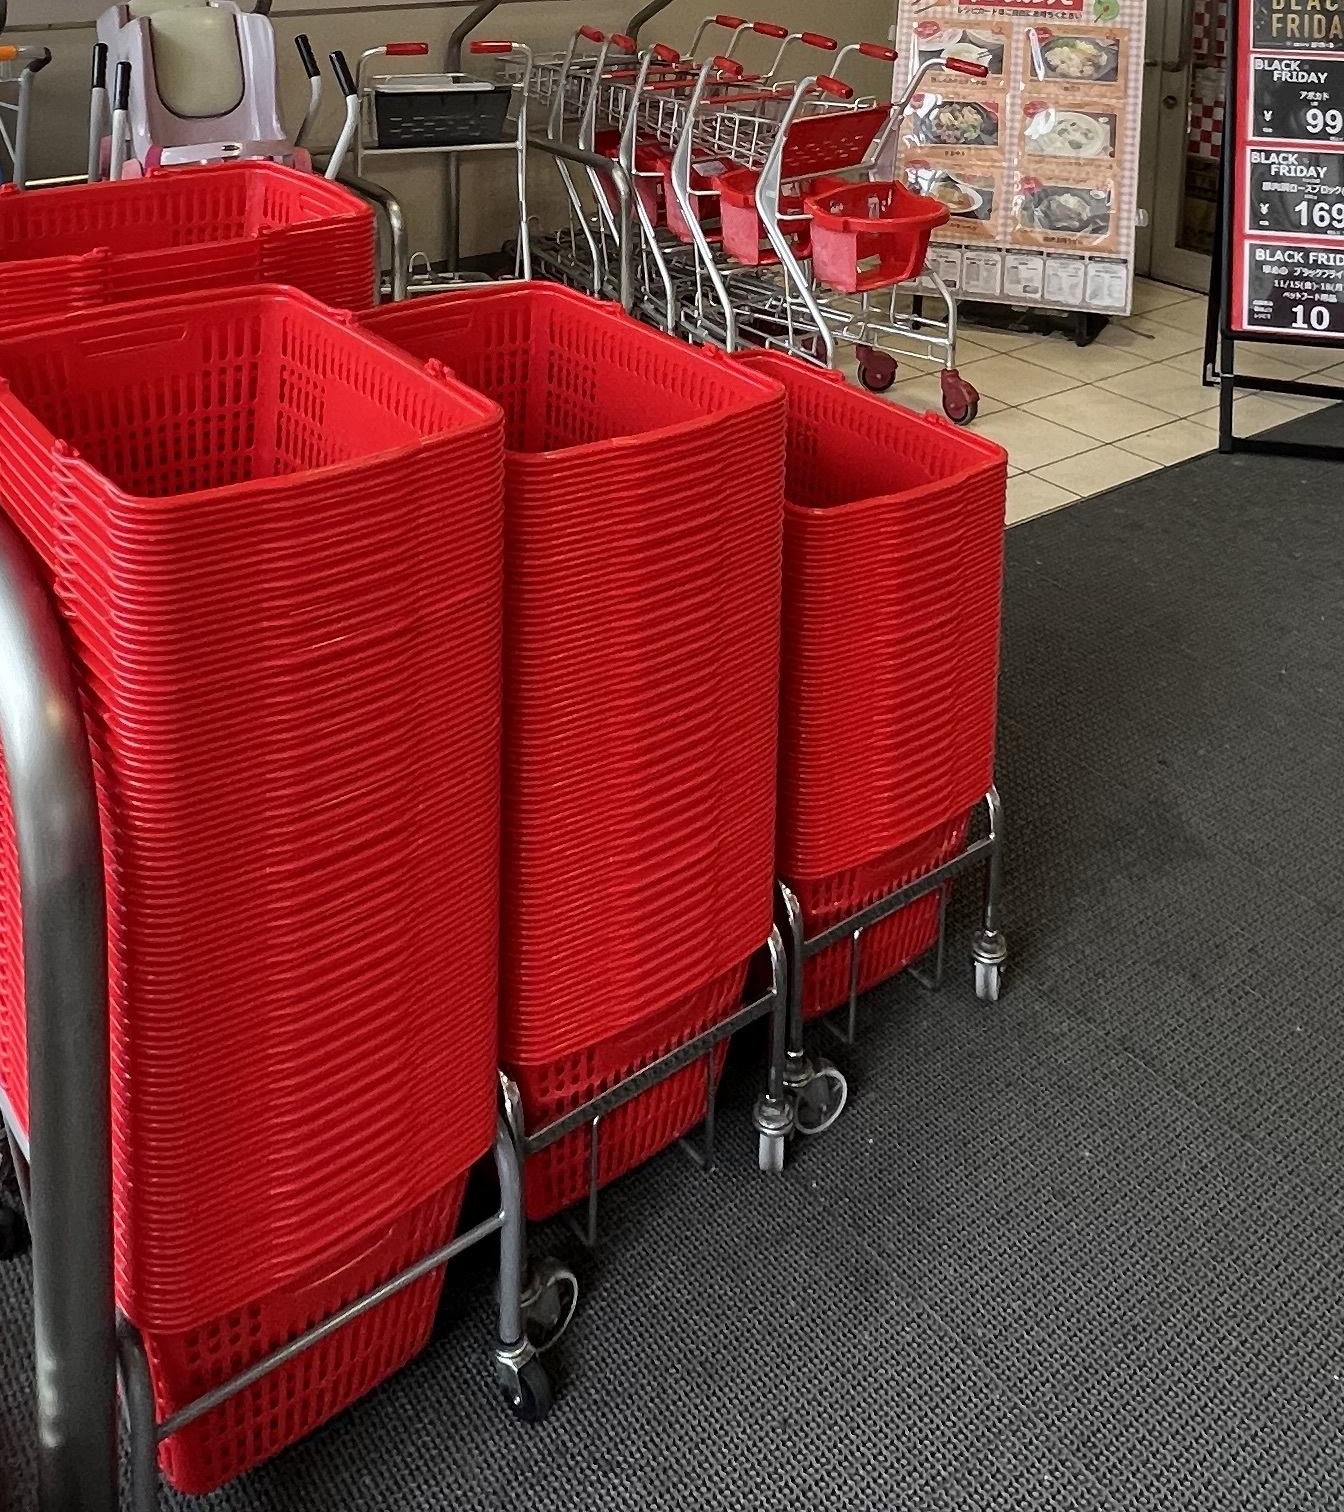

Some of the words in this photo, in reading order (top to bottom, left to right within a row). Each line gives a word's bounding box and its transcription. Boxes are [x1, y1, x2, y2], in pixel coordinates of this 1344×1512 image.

[1254, 59, 1301, 71] BLACK
[1273, 71, 1328, 83] FRIDAY
[1305, 108, 1343, 134] 99
[1251, 152, 1299, 165] BLACK
[1271, 165, 1328, 178] FRIDAY
[1255, 249, 1305, 264] BLACK
[1291, 304, 1330, 331] 10
